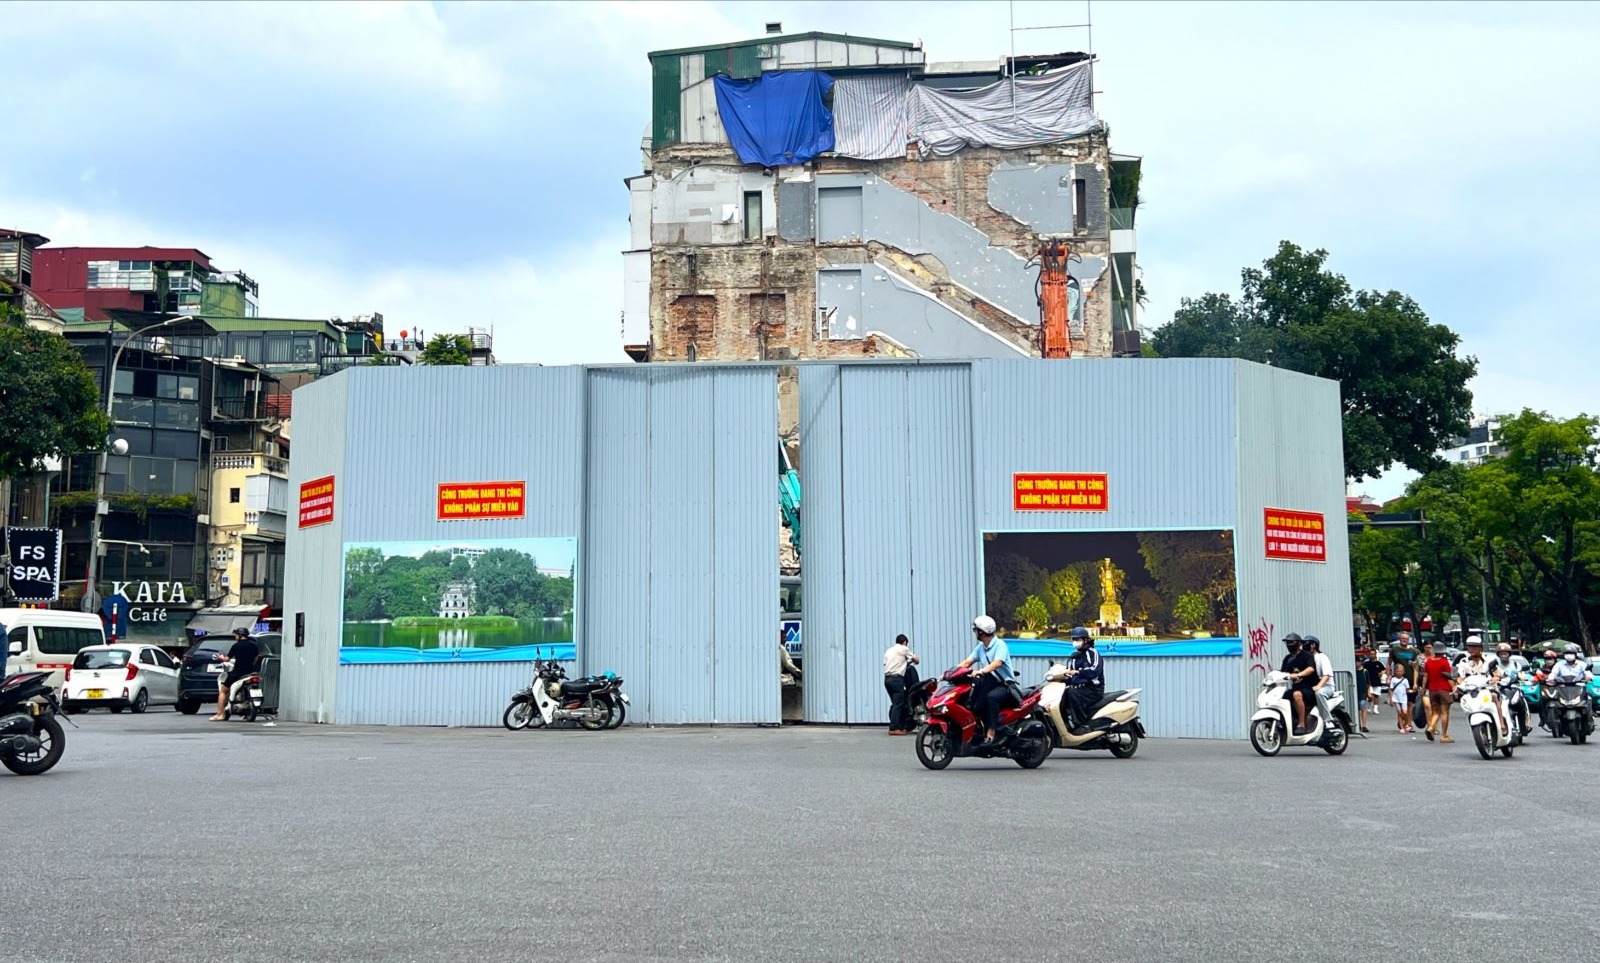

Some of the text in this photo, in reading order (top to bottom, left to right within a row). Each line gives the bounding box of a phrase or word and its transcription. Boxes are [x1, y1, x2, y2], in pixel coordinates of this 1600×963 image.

[20, 546, 46, 560] FS
[13, 566, 51, 581] SPA
[112, 581, 187, 604] KAFA
[128, 607, 168, 622] Café
